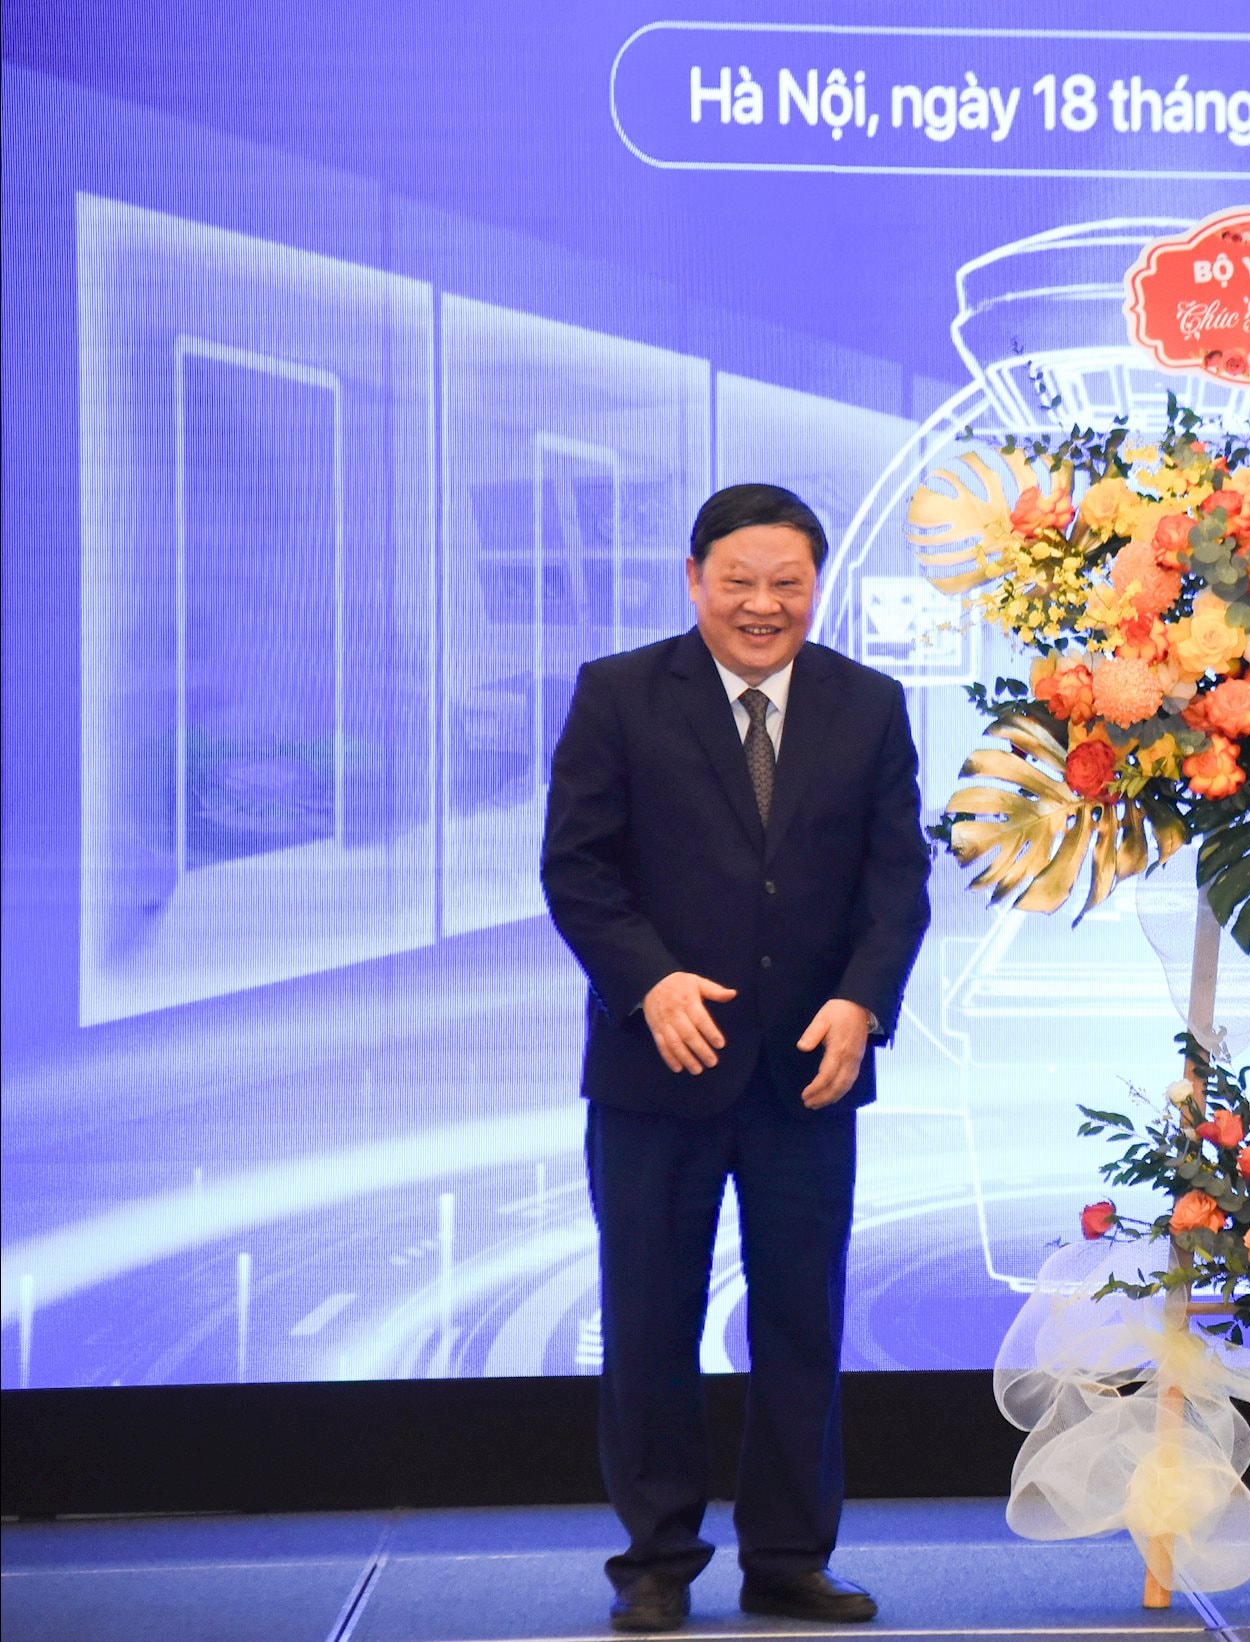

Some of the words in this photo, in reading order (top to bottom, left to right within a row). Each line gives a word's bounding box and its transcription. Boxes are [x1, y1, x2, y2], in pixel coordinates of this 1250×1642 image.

[689, 64, 764, 126] Hà
[777, 66, 880, 142] Nội,
[890, 69, 1021, 144] ngày
[1031, 72, 1098, 133] 18
[1193, 253, 1234, 288] BỘ
[1176, 300, 1240, 341] Chúc
